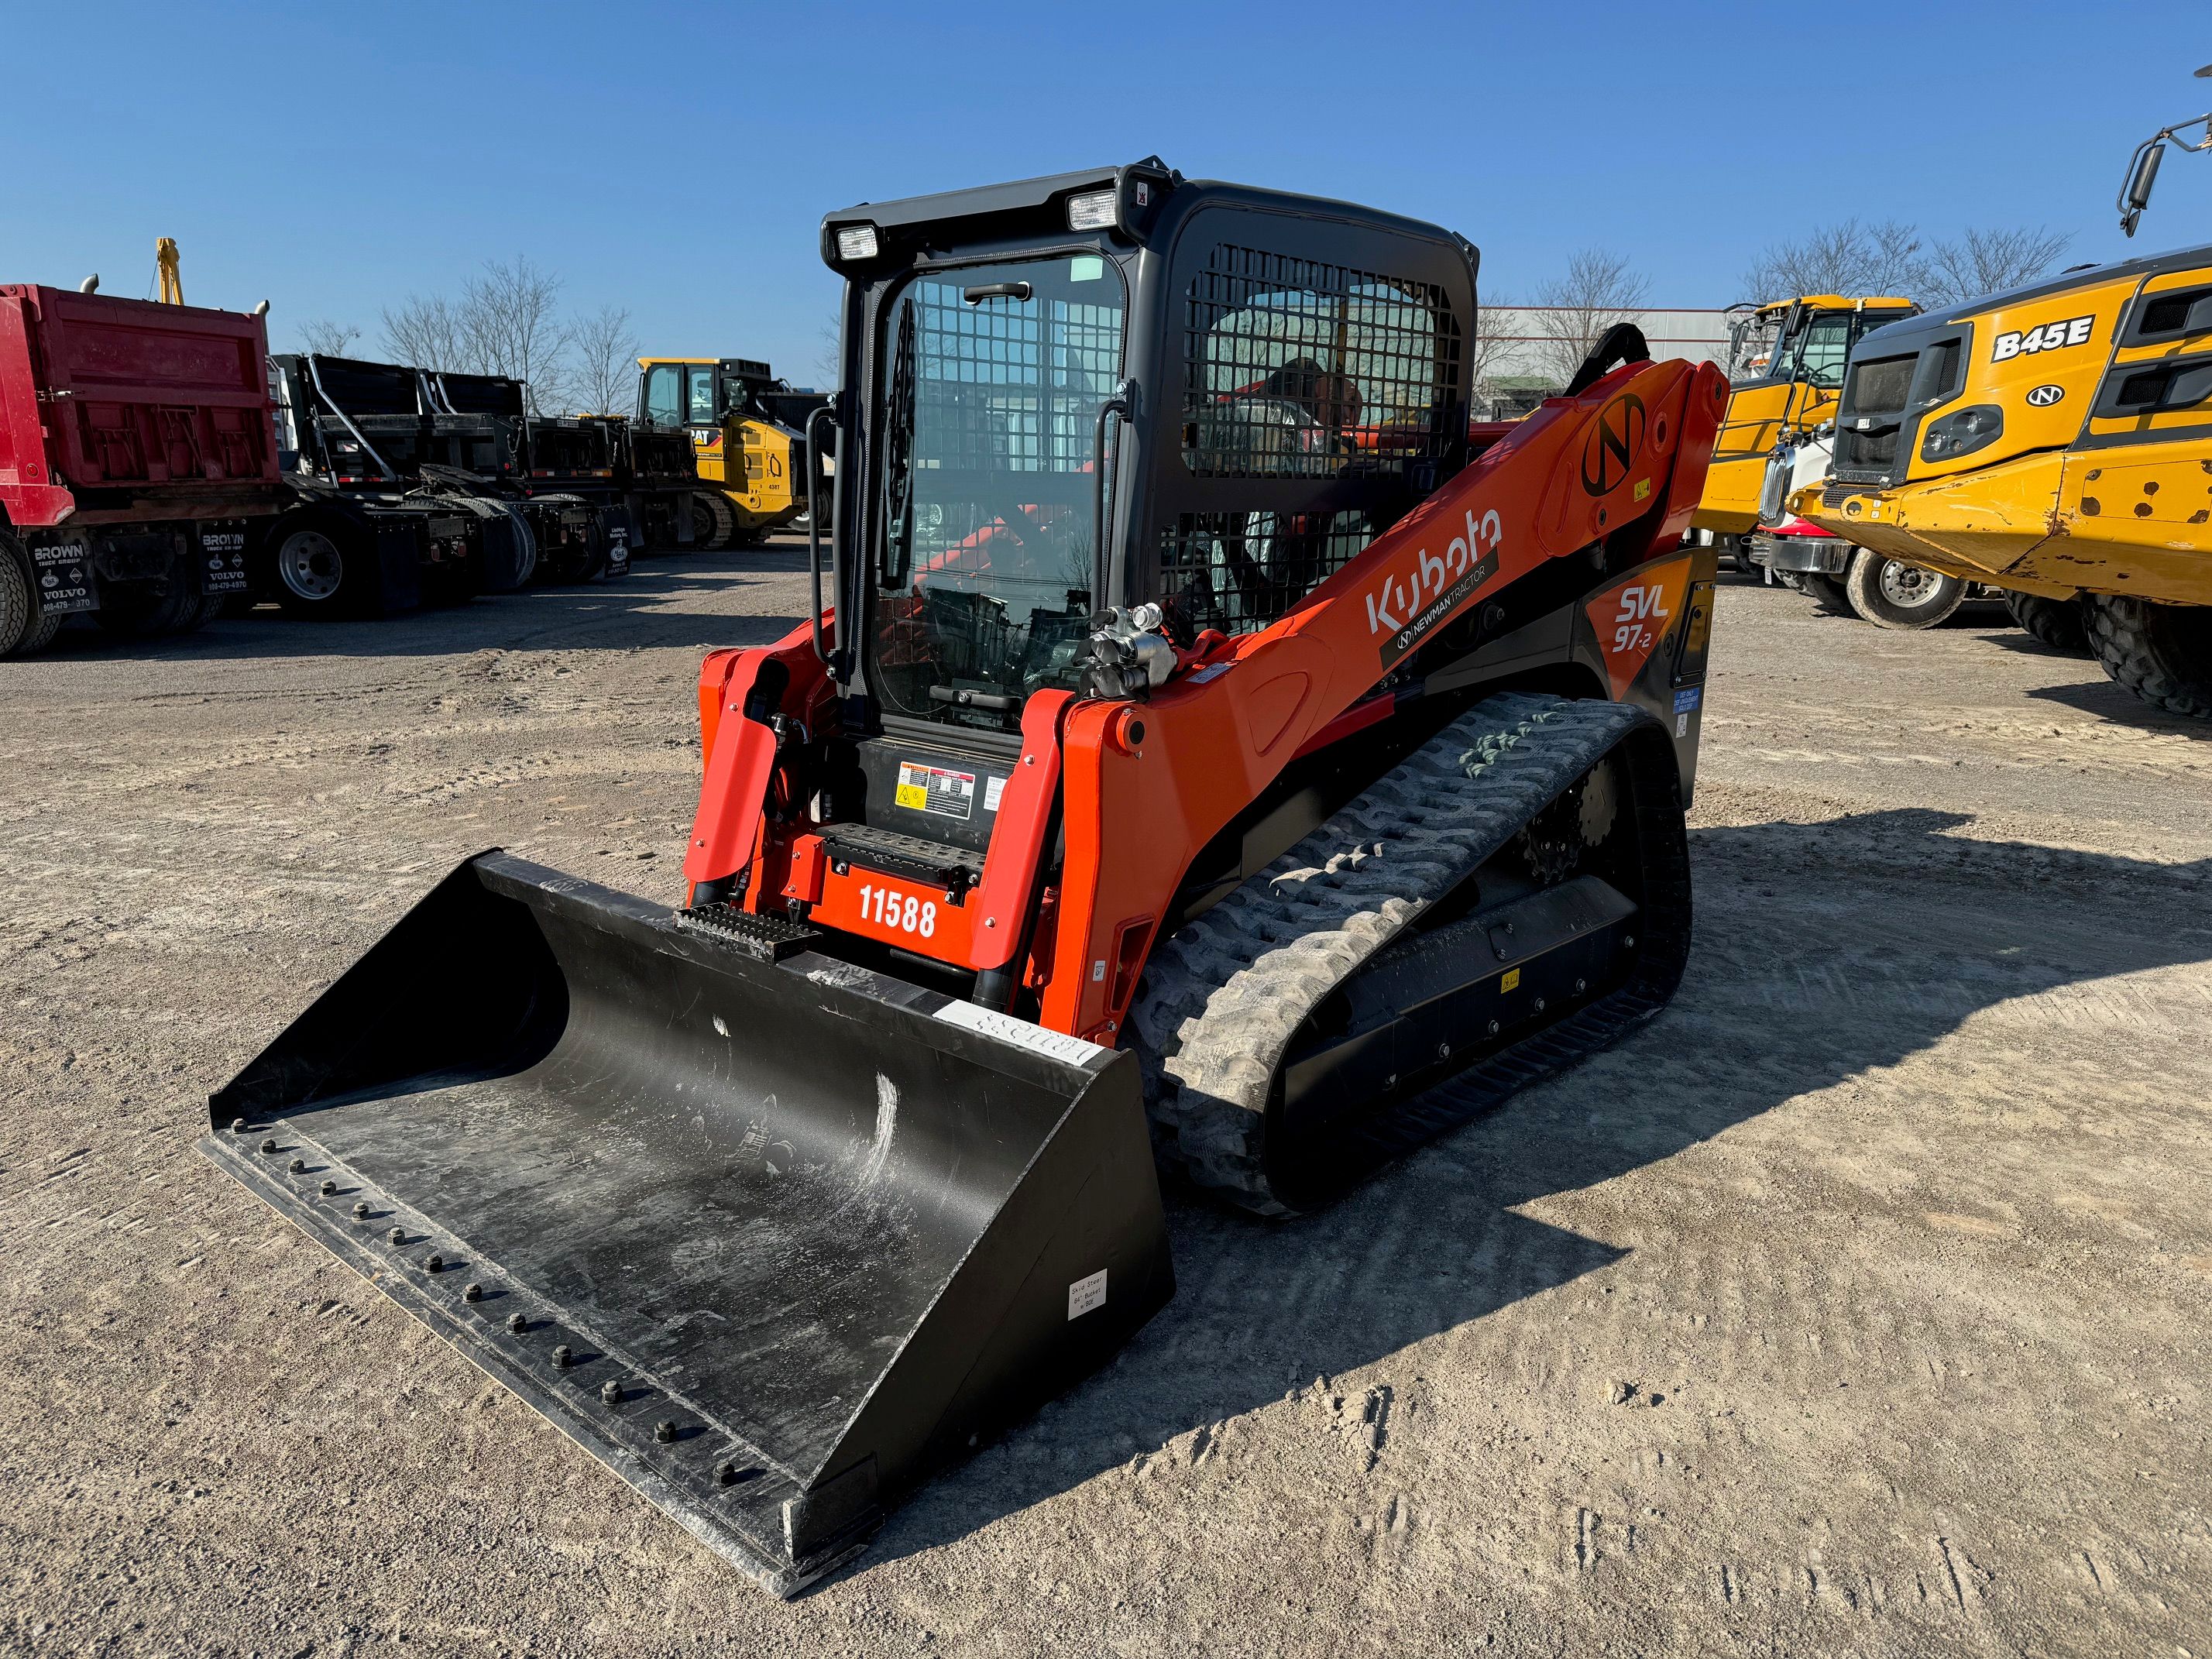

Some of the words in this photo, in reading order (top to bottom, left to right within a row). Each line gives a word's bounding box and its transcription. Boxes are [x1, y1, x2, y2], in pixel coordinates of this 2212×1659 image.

[1991, 314, 2095, 363] B45E
[203, 534, 244, 545] BROWN
[35, 544, 84, 560] BROWN
[210, 572, 244, 580] VOLVO
[1365, 509, 1502, 634] Kubota
[43, 588, 86, 599] VOLVO
[1616, 584, 1668, 623] SVL
[1613, 623, 1651, 653] 97-2
[860, 884, 936, 938] 11588
[1072, 1284, 1085, 1294] Skid
[1087, 1276, 1103, 1287] Steer
